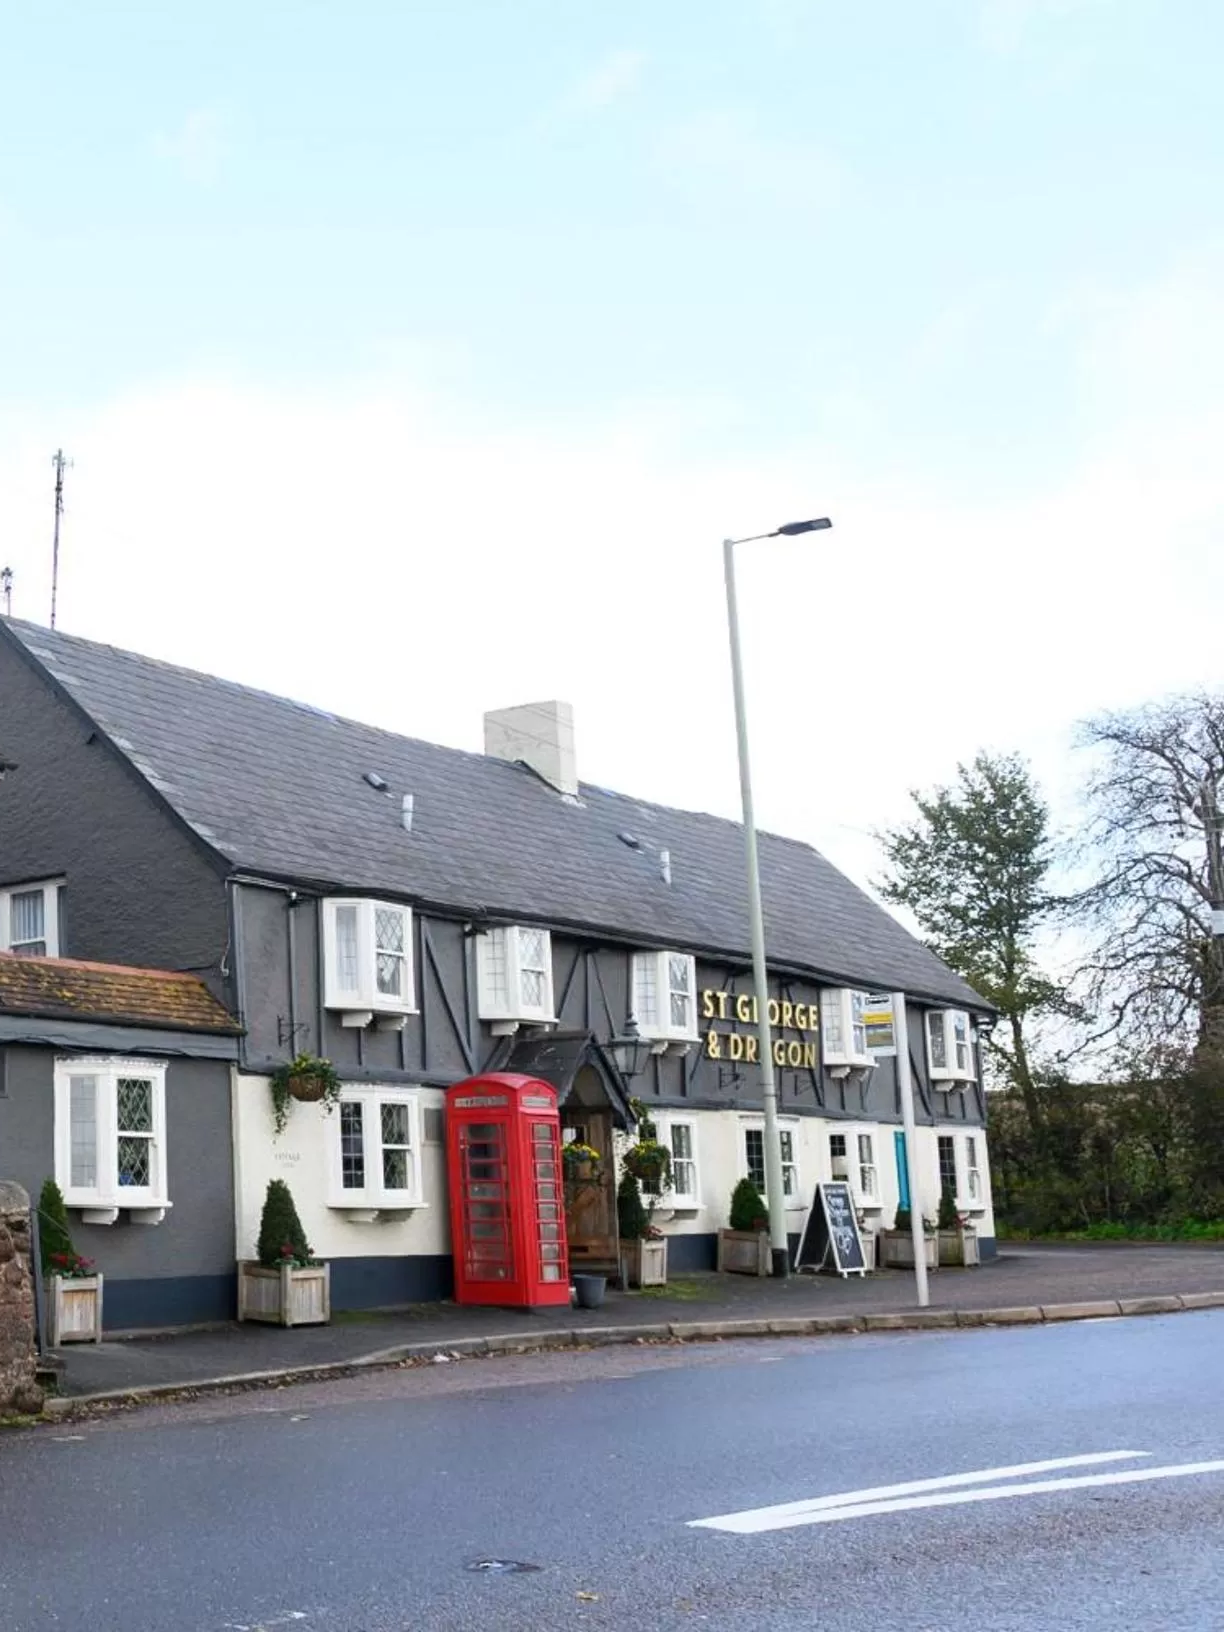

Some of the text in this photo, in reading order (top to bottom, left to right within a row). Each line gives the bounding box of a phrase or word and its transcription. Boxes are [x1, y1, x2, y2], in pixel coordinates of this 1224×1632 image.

[703, 989, 728, 1019] ST
[708, 1030, 815, 1068] & DRGON
